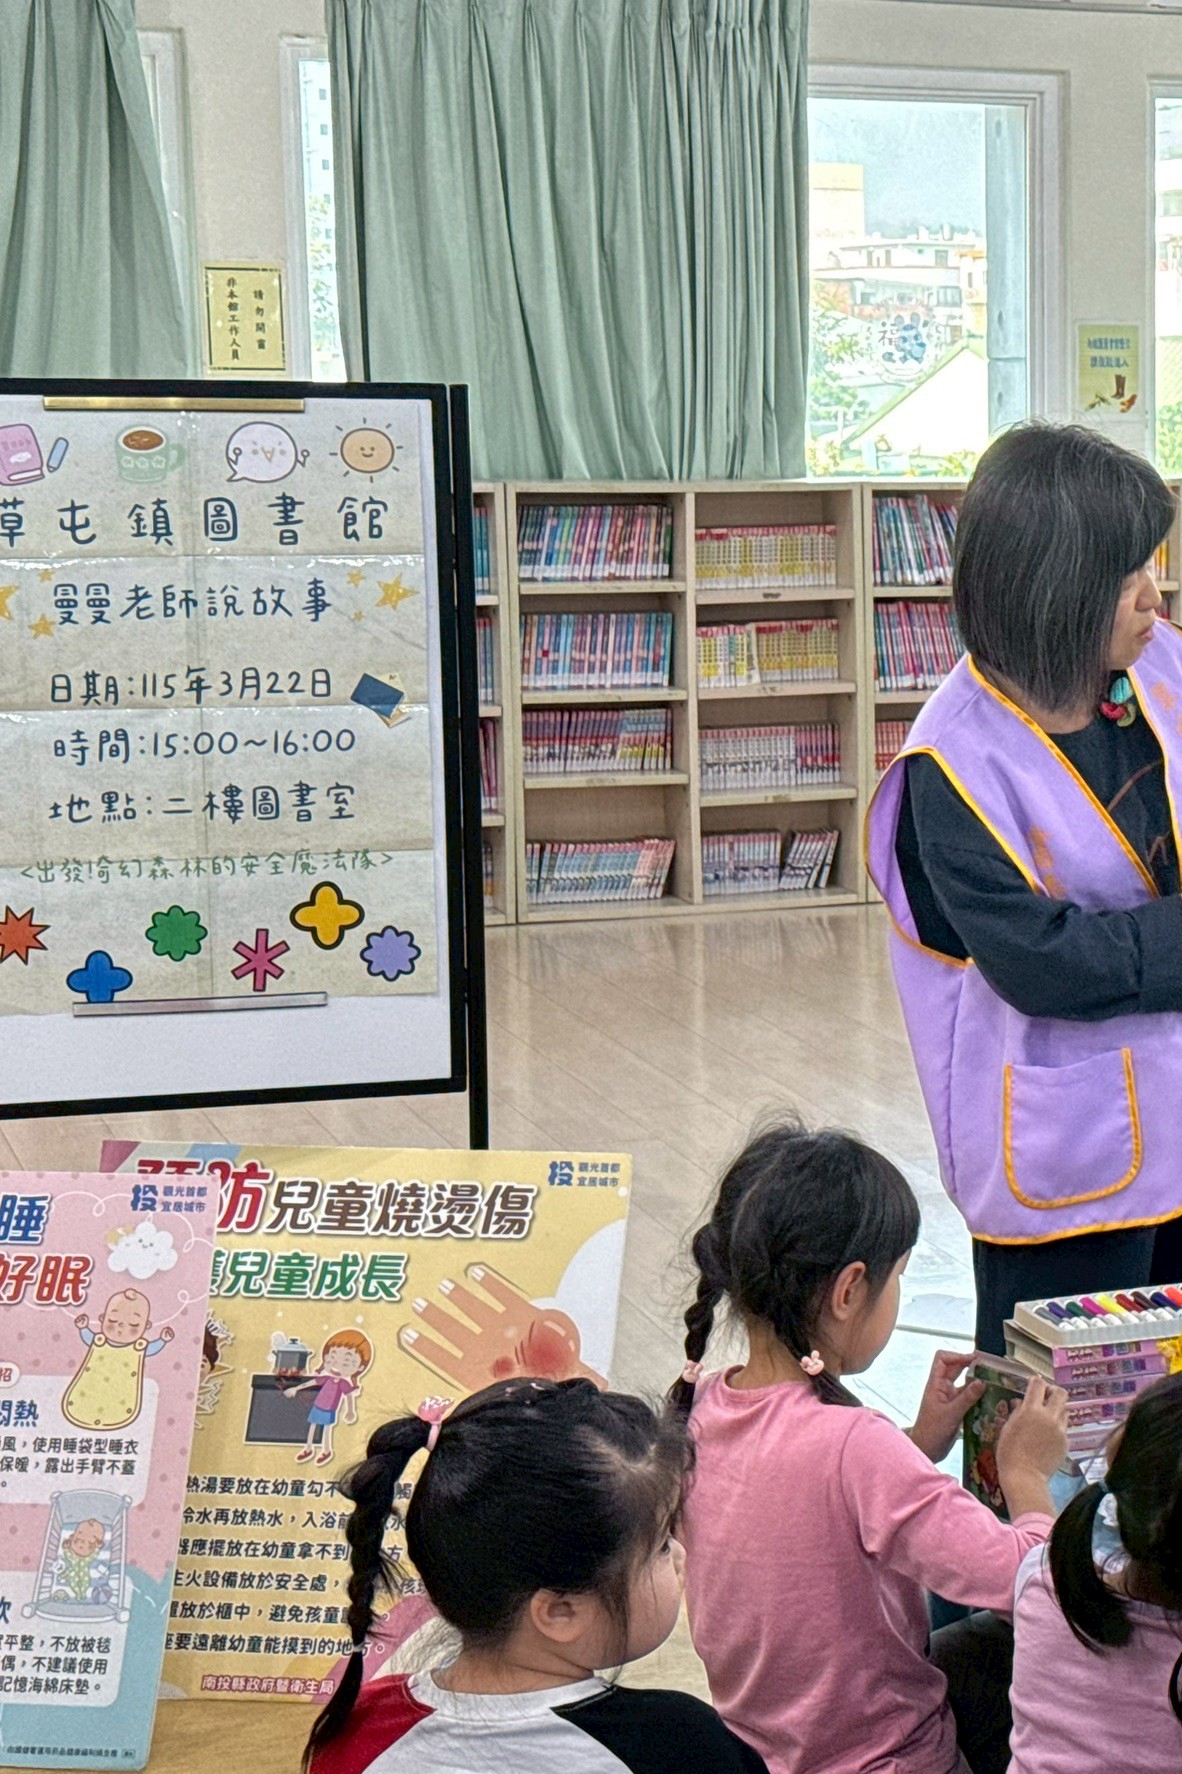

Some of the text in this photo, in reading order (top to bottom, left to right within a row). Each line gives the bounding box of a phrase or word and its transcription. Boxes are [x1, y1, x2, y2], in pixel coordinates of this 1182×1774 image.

[0, 492, 389, 546] 草屯鎮圖書館
[53, 577, 332, 625] 曼曼老師說故事
[48, 782, 356, 824] 地點:二樓圖書室
[138, 1159, 538, 1236] 防兒童燒燙傷
[0, 1436, 139, 1455] 風，使用睡袋型睡衣
[0, 1634, 112, 1654] 平整，不放被毯
